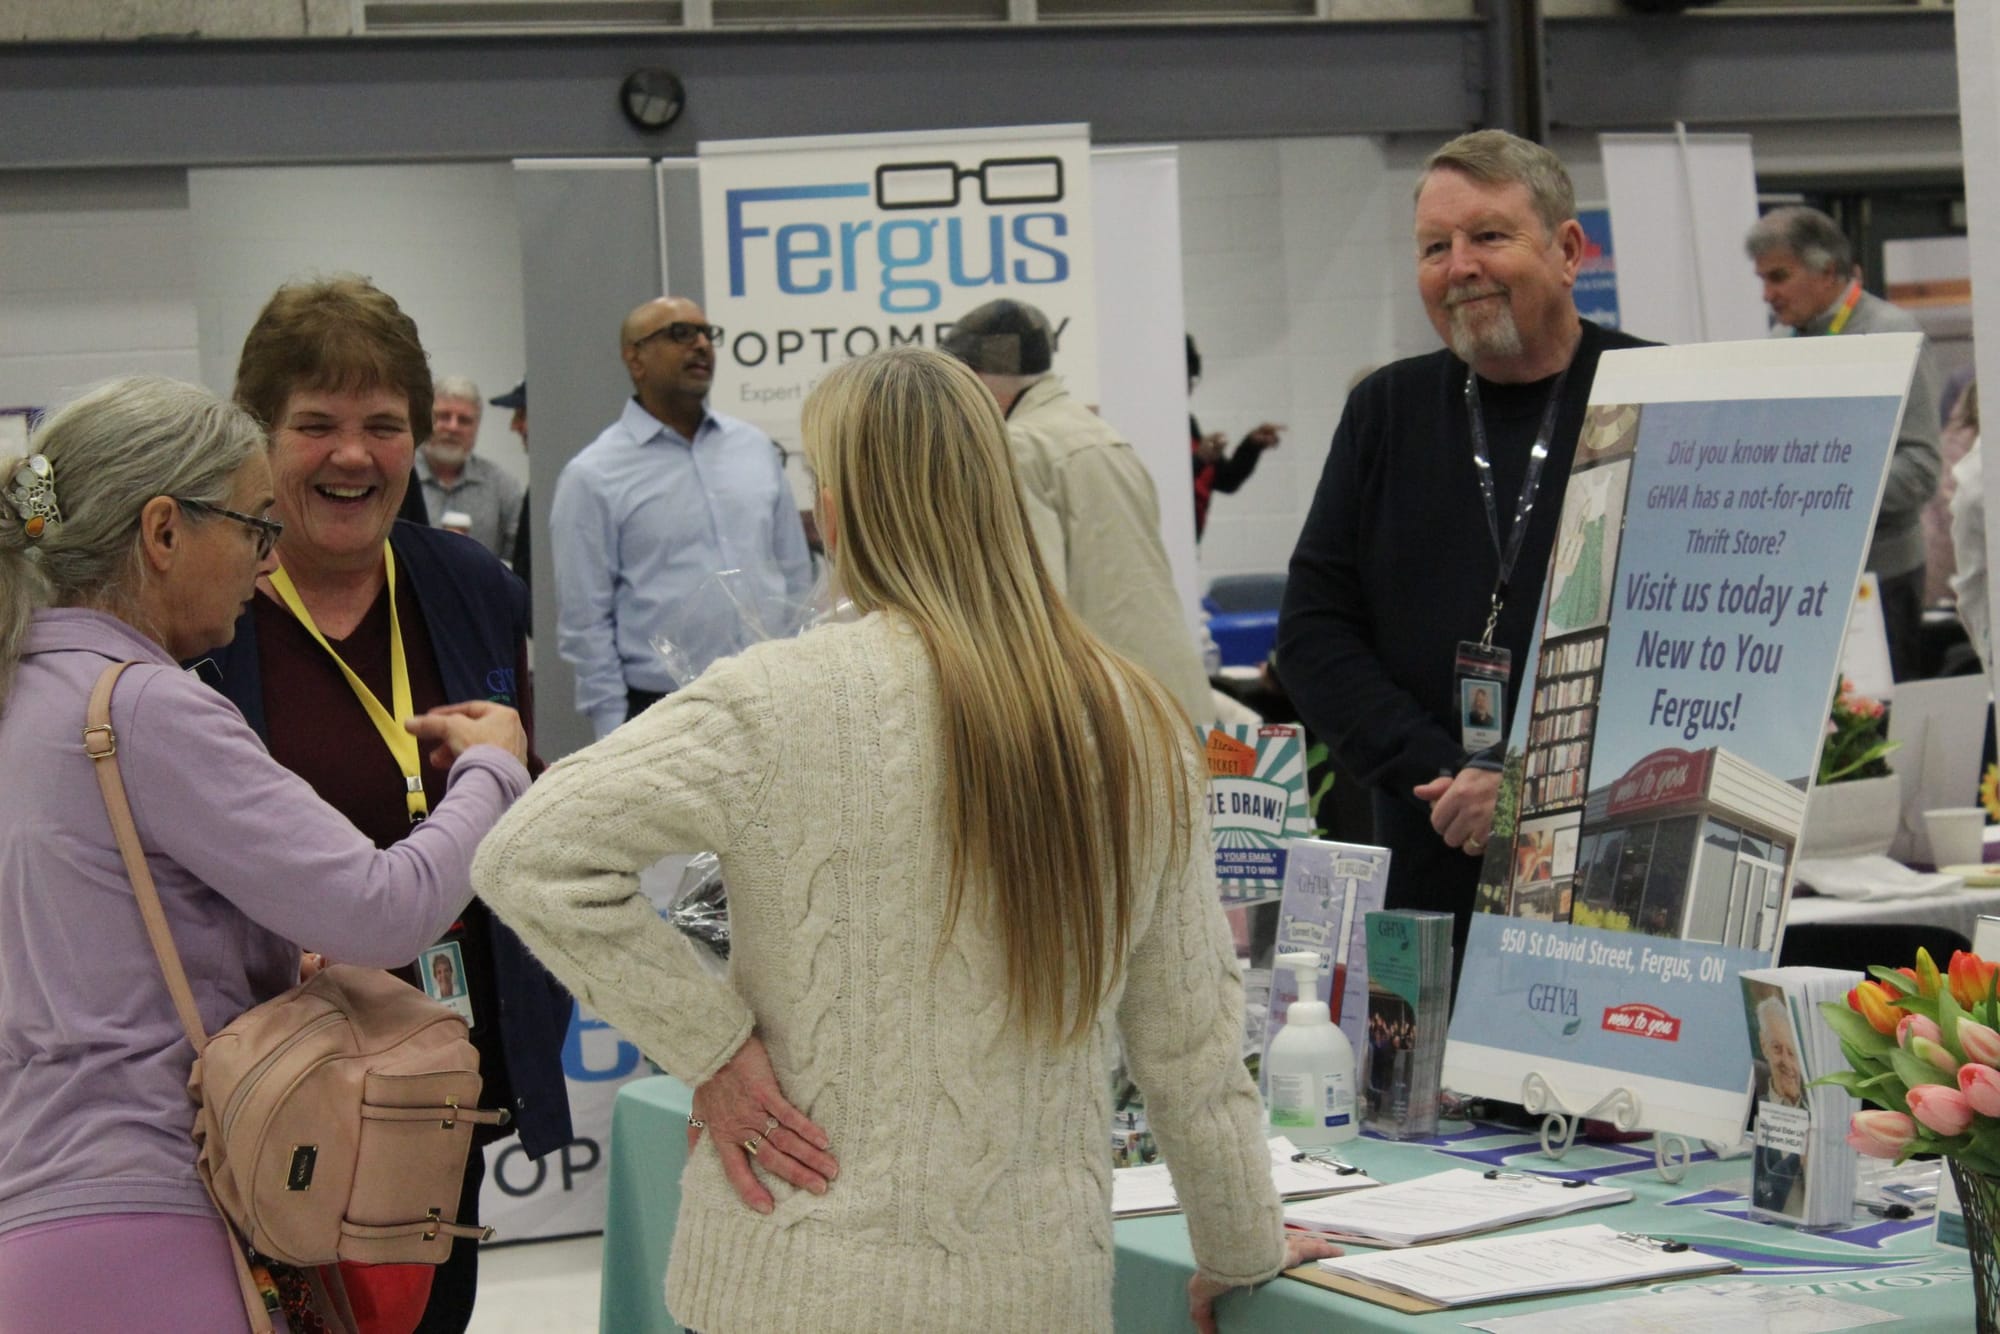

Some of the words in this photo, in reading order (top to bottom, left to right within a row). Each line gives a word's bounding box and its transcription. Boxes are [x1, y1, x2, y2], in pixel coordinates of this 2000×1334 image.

[725, 182, 1071, 314] Fergus
[733, 317, 1070, 367] OPTOMY
[740, 382, 800, 404] Expert
[1667, 440, 1697, 465] Did
[1695, 444, 1728, 472] you
[1731, 438, 1780, 464] know
[1782, 437, 1820, 464] that
[1822, 436, 1852, 464] the
[1647, 484, 1689, 510] GHVA
[1691, 484, 1721, 510] has
[1723, 489, 1735, 510] a
[1738, 482, 1854, 517] not-for-profit
[1686, 528, 1730, 555] Thrift
[1732, 528, 1787, 555] Store?
[1625, 571, 1678, 612] Visit
[1681, 582, 1712, 614] us
[1717, 573, 1794, 628] today
[1797, 580, 1829, 617] at
[1636, 630, 1695, 670] New
[1699, 635, 1726, 671] to
[1735, 633, 1785, 675] You
[1649, 688, 1743, 741] Fergus!
[1231, 792, 1283, 823] DRAW!
[1501, 927, 1527, 954] 950
[1528, 931, 1544, 957] St
[1545, 933, 1587, 964] David
[1587, 940, 1635, 974] Street,
[1640, 947, 1693, 984] Fergus,
[1700, 956, 1727, 984] ON
[1528, 983, 1579, 1017] GHVA
